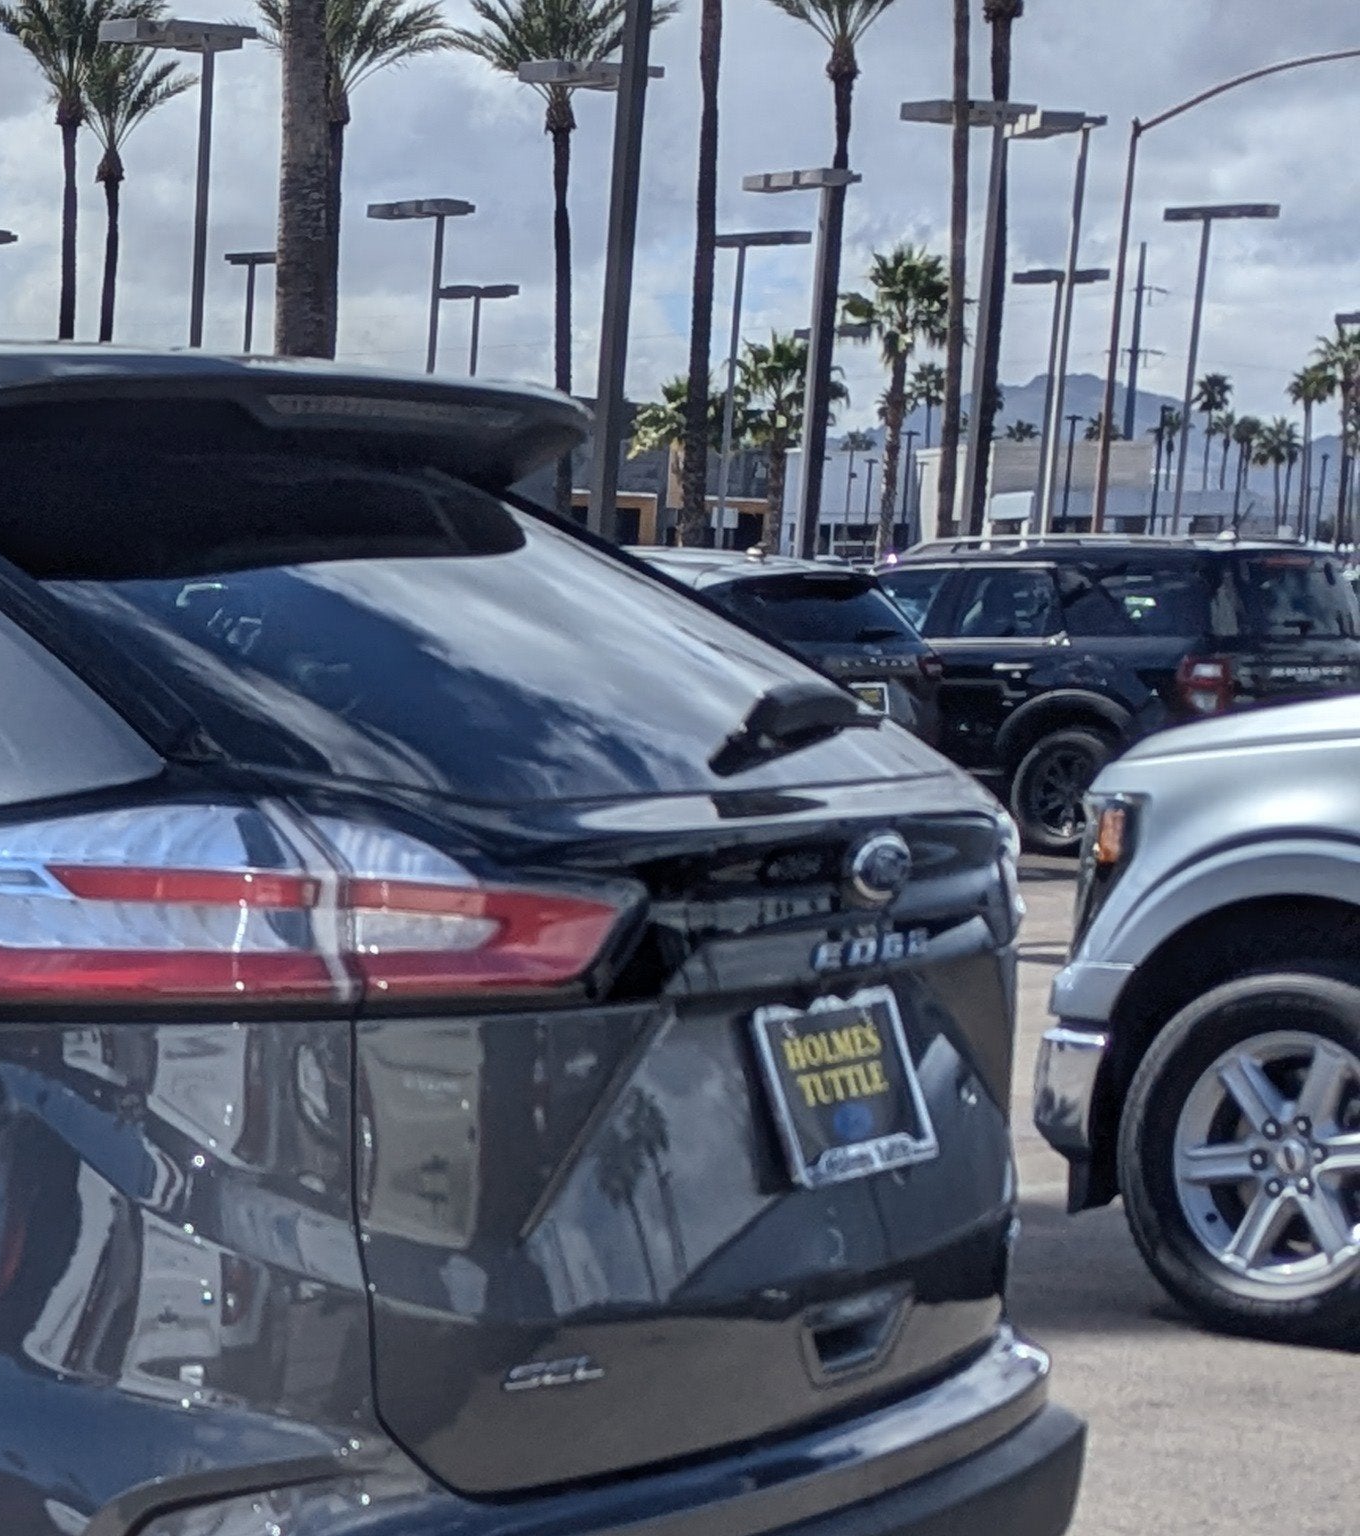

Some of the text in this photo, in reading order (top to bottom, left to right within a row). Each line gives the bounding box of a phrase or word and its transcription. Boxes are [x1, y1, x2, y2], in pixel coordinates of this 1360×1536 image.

[812, 927, 930, 970] EDGE
[783, 1025, 882, 1070] HOLMES
[797, 1060, 890, 1107] TUTTLE
[504, 1356, 605, 1391] SEL
